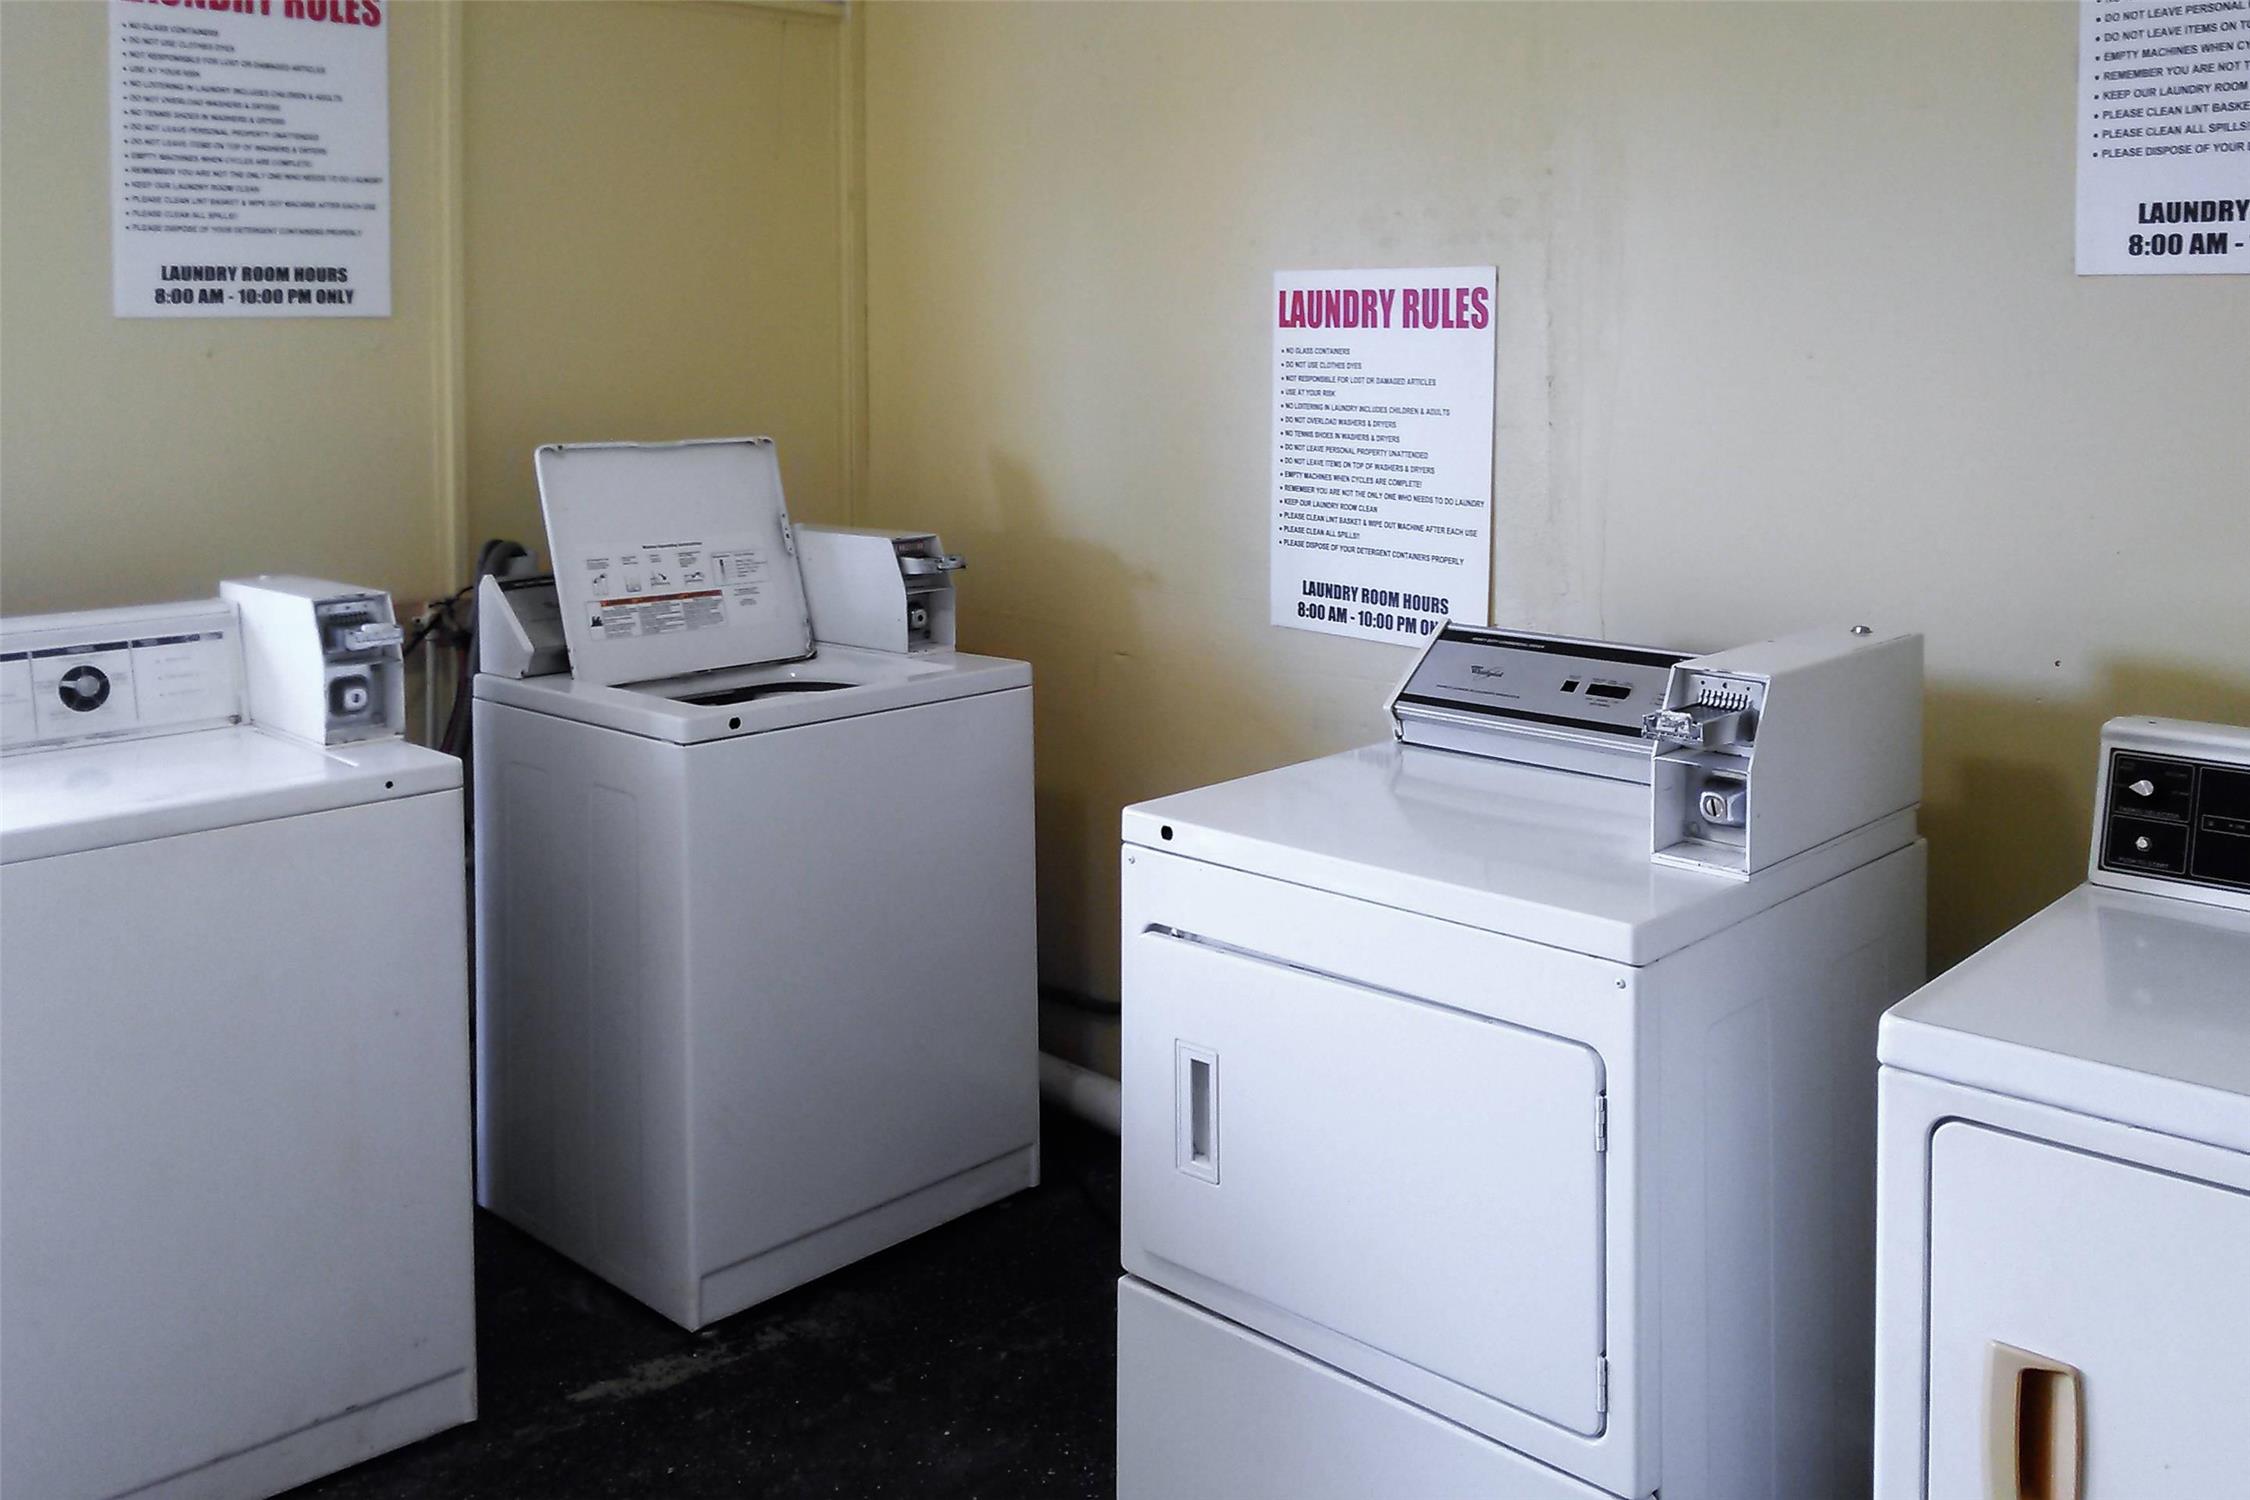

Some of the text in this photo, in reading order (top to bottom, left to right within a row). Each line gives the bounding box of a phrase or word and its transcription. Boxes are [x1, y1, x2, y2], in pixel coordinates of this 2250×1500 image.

[2105, 1, 2246, 22] DO NOT LEAVE PERSONAL
[2104, 33, 2120, 42] DO
[2123, 30, 2144, 40] NOT
[2147, 27, 2182, 38] LEAVE
[2185, 23, 2218, 35] ITEMS
[2220, 22, 2237, 32] ON
[2104, 50, 2138, 61] EMPTY
[2142, 45, 2198, 58] MACHINES
[2201, 42, 2234, 53] WHEN
[2104, 62, 2241, 81] REMEMBER YOU ARE NOT
[2103, 82, 2249, 100] KEEP OUR LAUNDRY ROOM
[2103, 101, 2250, 120] PLEASE CLEAN LINT BASKE
[2103, 125, 2206, 139] PLEASE CLEAN ALL
[2102, 142, 2245, 158] PLEASE DISPOSE OF YOUR
[2138, 199, 2250, 224] LAUNDRY
[2128, 233, 2228, 256] 8:00 AM
[161, 266, 348, 283] LAUNDRY ROOM HOURS
[154, 288, 194, 304] 8:00
[198, 288, 224, 304] AM
[238, 288, 283, 304] 10:00
[288, 289, 312, 304] PM
[316, 289, 354, 304] ONLY
[1278, 287, 1489, 330] LAUNDRY RULES
[1298, 375, 1336, 383] RESPONSIBLE
[1376, 377, 1406, 385] DAMAGED
[1407, 378, 1436, 386] ARTICLES
[1286, 388, 1296, 396] USE
[1294, 402, 1323, 410] LOITERING
[1331, 404, 1358, 412] LAUNDRY
[1426, 408, 1450, 416] ADULTS
[1307, 417, 1337, 425] OVERLOAD
[1373, 420, 1396, 428] DRYERS
[1294, 430, 1314, 438] TENNIS
[1342, 433, 1369, 441] WASHERS
[1376, 435, 1400, 443] DRYERS
[1325, 446, 1355, 454] PERSONAL
[1356, 448, 1387, 456] PROPERTY
[1388, 450, 1428, 459] UNATTENDED
[1325, 460, 1341, 468] ITEMS
[1374, 463, 1403, 472] WASHERS
[1410, 466, 1435, 474] DRYERS
[1304, 472, 1332, 481] MACHINES
[1333, 474, 1350, 482] WHEN
[1351, 476, 1373, 484] CYCLES
[1284, 484, 1315, 493] REMEMBER
[1329, 488, 1340, 496] ARE
[1355, 490, 1365, 498] THE
[1413, 495, 1433, 503] NEEDS
[1455, 498, 1484, 508] LAUNDRY
[1284, 498, 1378, 513] KEEP OUR LAUNDRY ROOM CLEAN
[1284, 512, 1305, 520] PLEASE
[1306, 514, 1324, 522] CLEAN
[1339, 517, 1361, 526] BASKET
[1368, 520, 1382, 528] WIPE
[1384, 521, 1396, 529] OUT
[1397, 523, 1424, 532] MACHINE
[1426, 525, 1445, 534] AFTER
[1447, 527, 1463, 536] EACH
[1465, 529, 1478, 537] USE
[1284, 525, 1305, 534] PLEASE
[1306, 528, 1324, 536] CLEAN
[1283, 539, 1304, 548] PLEASE
[1306, 541, 1329, 550] DISPOSE
[1340, 545, 1355, 553] YOUR
[1357, 547, 1391, 557] DETERGENT
[1392, 551, 1430, 562] CONTAINERS
[1431, 555, 1464, 565] PROPERLY
[1302, 580, 1449, 615] LAUNDRY ROOM HOURS
[1298, 602, 1325, 620] 8:00
[1328, 608, 1347, 624] AM
[1358, 610, 1394, 631] 10:00
[1397, 616, 1417, 634] PM
[1420, 619, 1439, 636] ON
